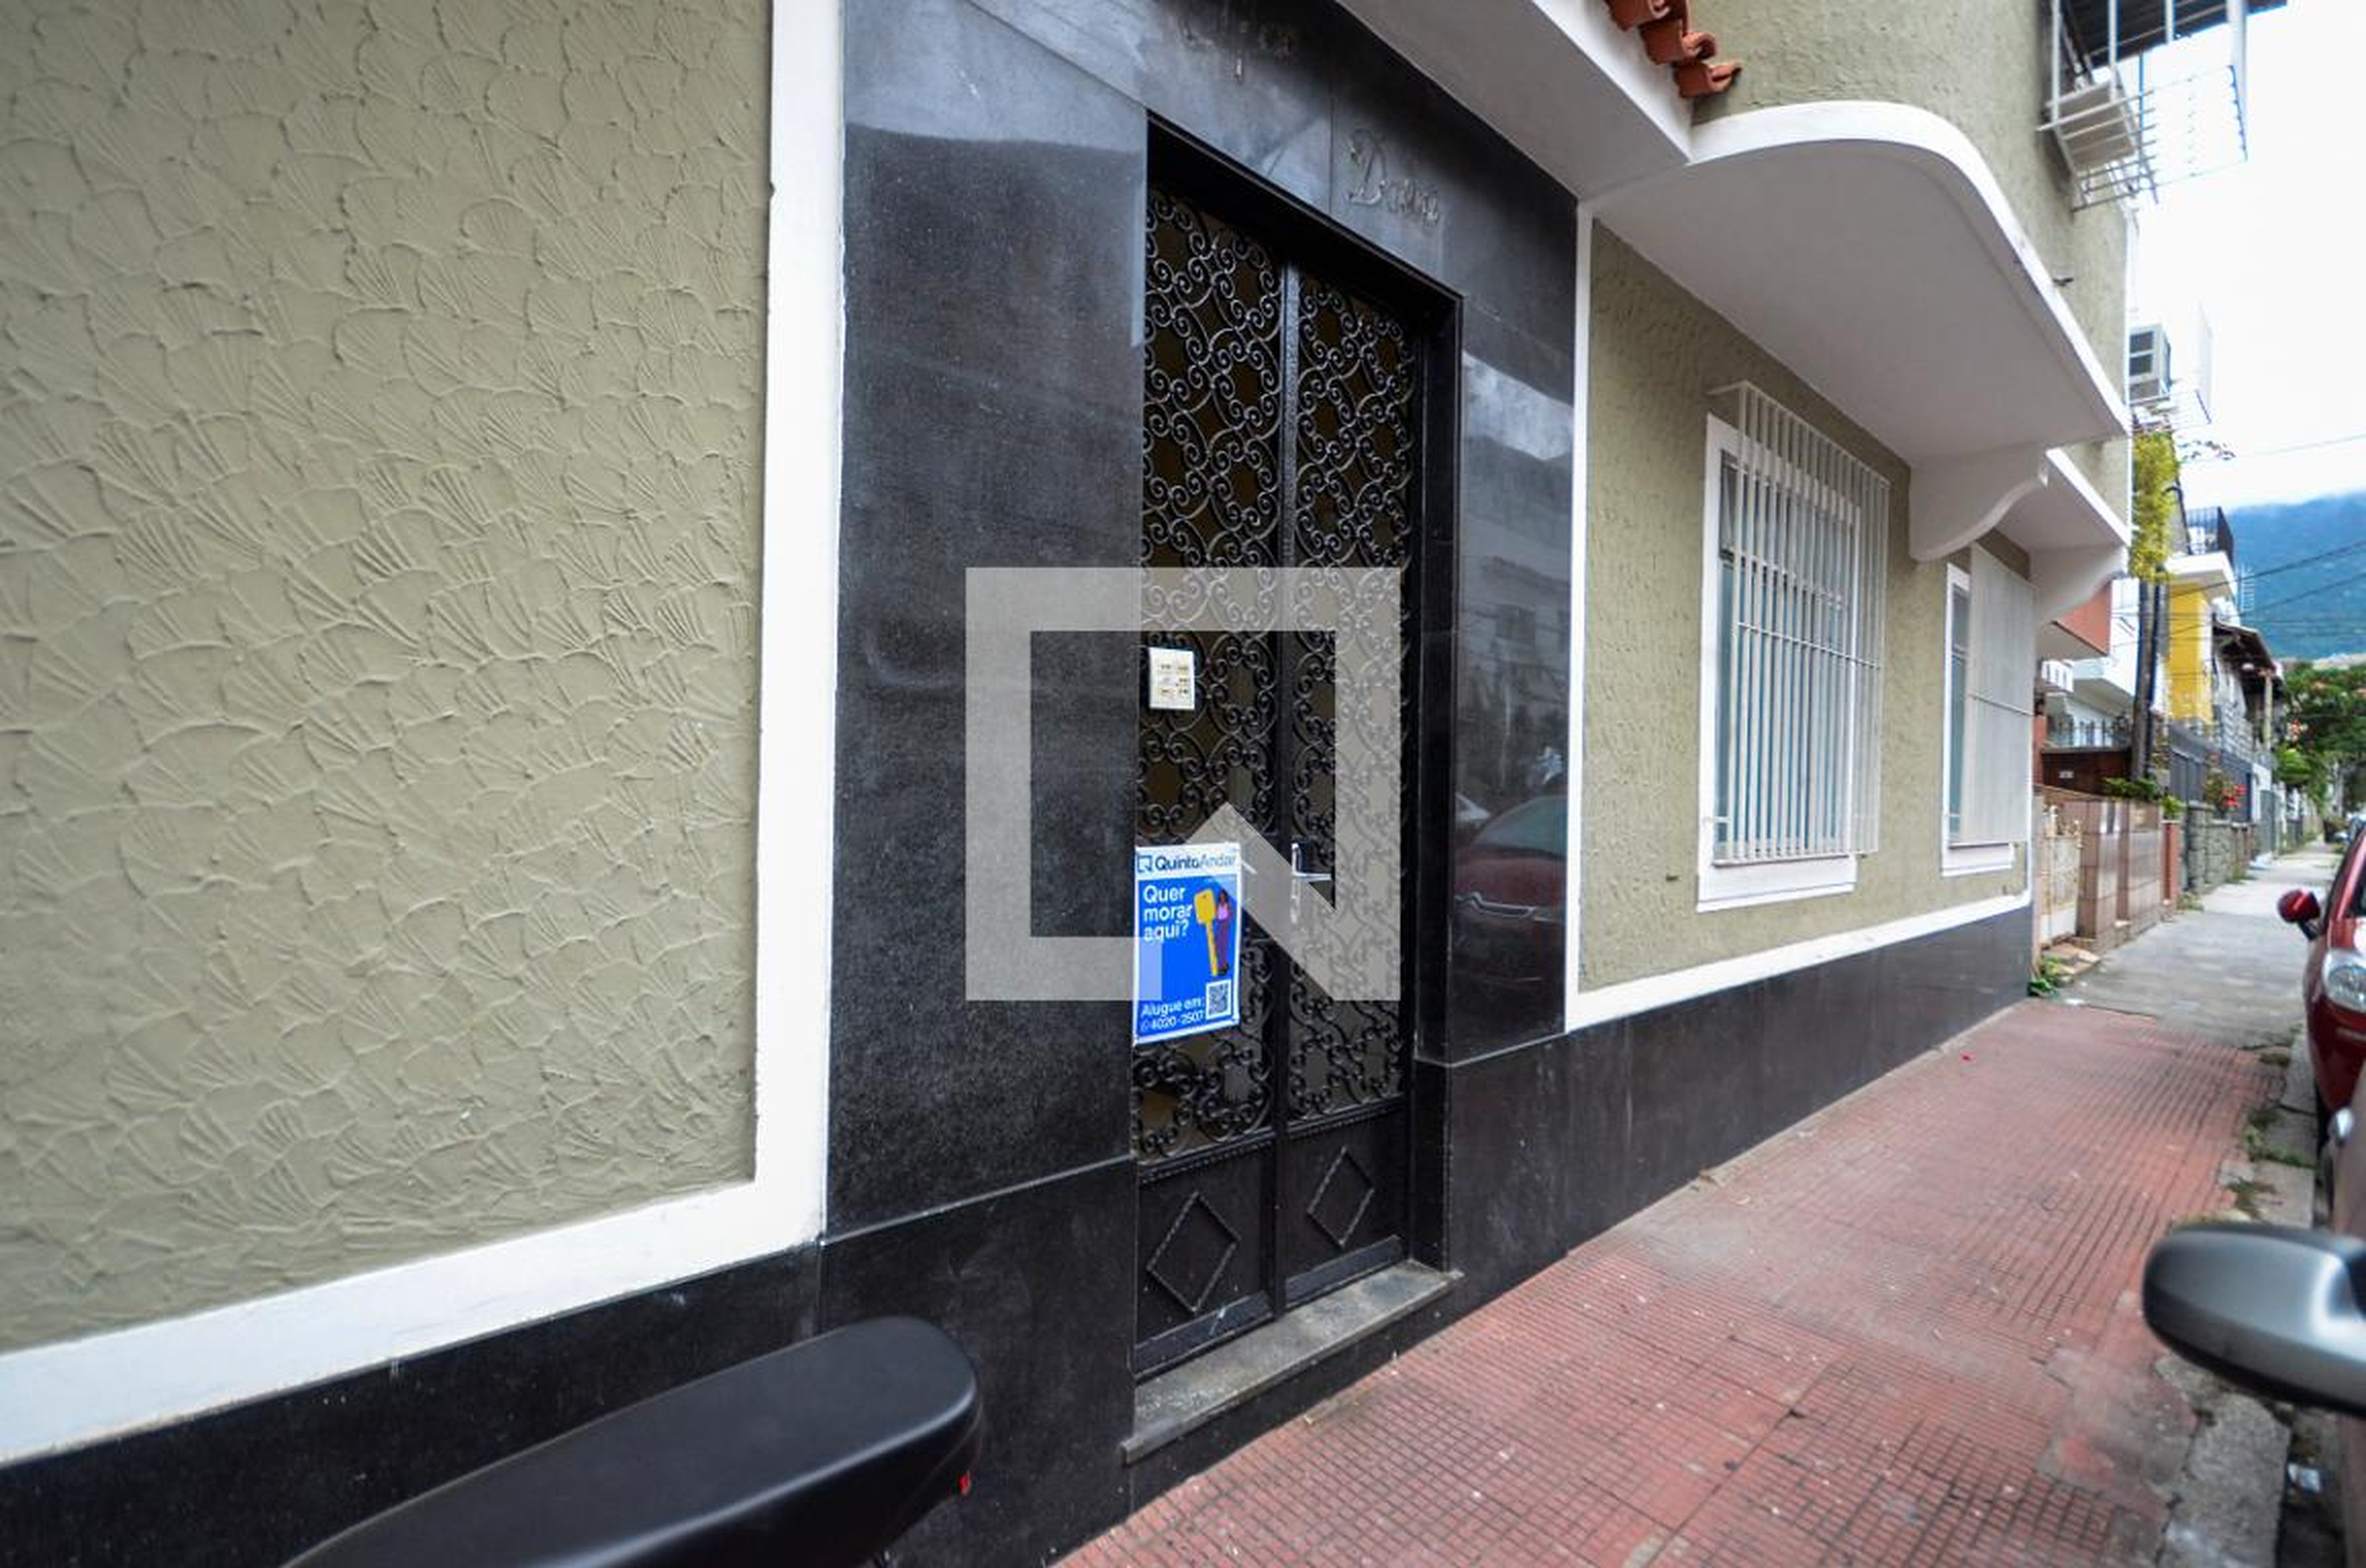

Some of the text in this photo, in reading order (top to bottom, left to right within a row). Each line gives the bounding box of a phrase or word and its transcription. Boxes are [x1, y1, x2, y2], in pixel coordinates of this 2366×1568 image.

[1143, 885, 1185, 903] Quer
[1144, 904, 1192, 922] morar
[1144, 919, 1189, 944] aqui?
